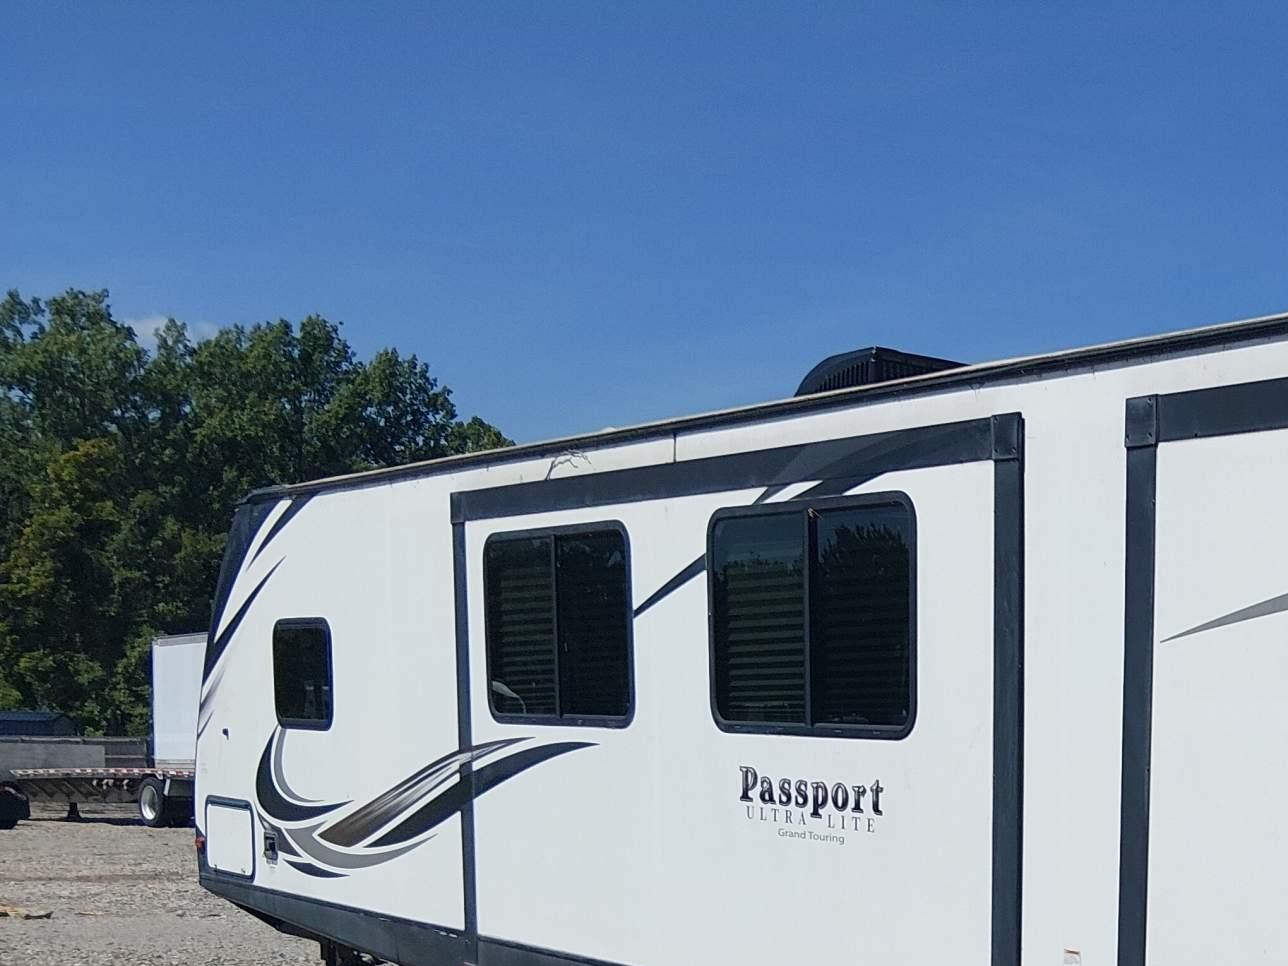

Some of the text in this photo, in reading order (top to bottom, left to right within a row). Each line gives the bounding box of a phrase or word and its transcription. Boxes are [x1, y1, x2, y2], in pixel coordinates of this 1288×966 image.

[739, 765, 884, 819] Passport
[746, 805, 876, 833] ULTRA LITE
[777, 828, 845, 845] Grand Touring
